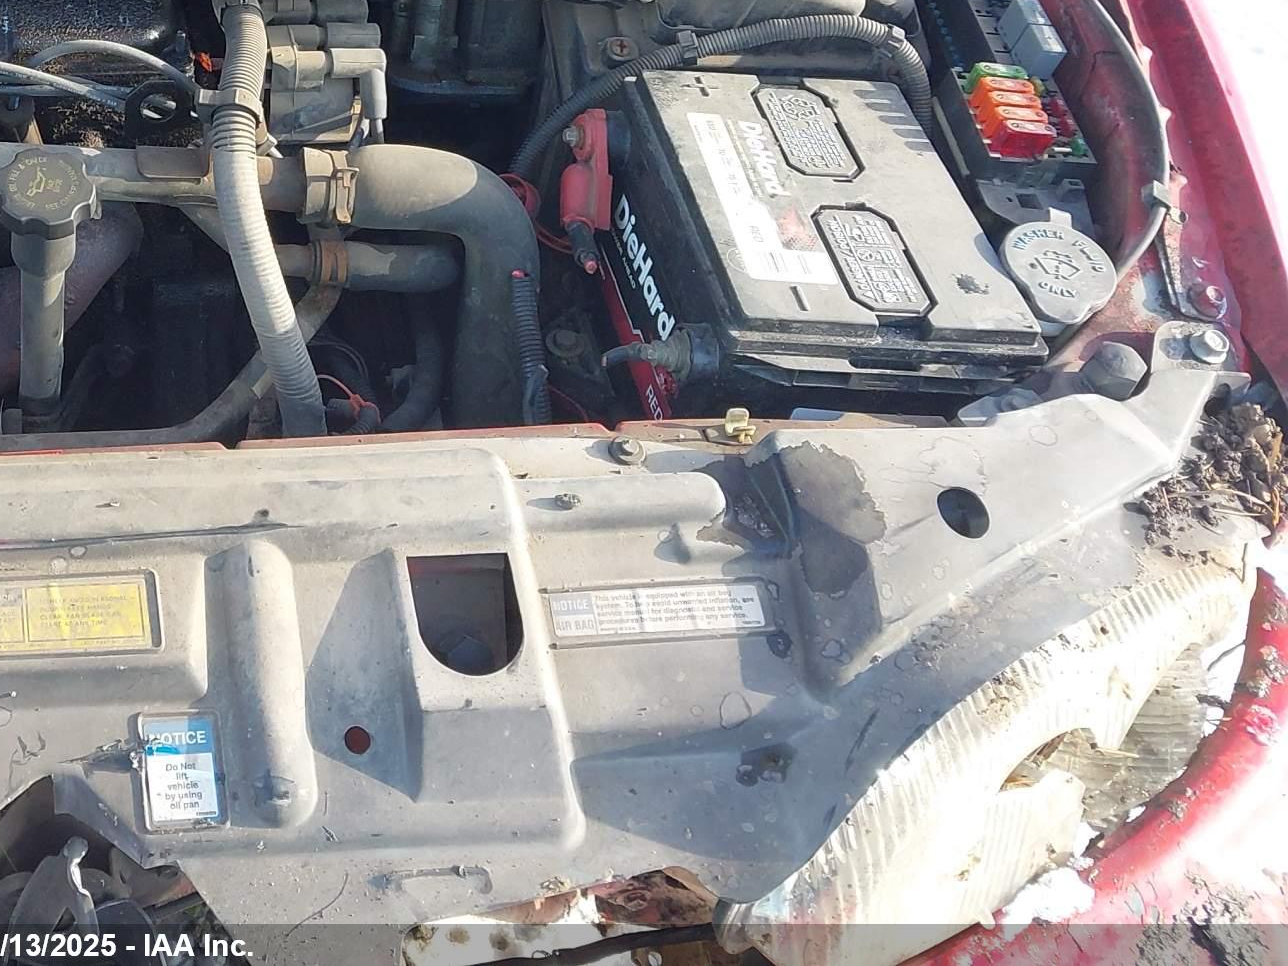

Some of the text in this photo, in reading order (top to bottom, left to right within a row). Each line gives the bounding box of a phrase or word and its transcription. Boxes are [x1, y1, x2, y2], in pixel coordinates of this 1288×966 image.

[738, 120, 792, 198] DieHard
[615, 194, 675, 342] DieHard
[1038, 281, 1076, 298] ONLY
[552, 598, 590, 611] NOTICE
[574, 618, 594, 631] BAG
[165, 762, 196, 772] Do Not
[167, 780, 199, 791] vehicle
[165, 790, 203, 802] by using
[169, 801, 200, 811] oil pan
